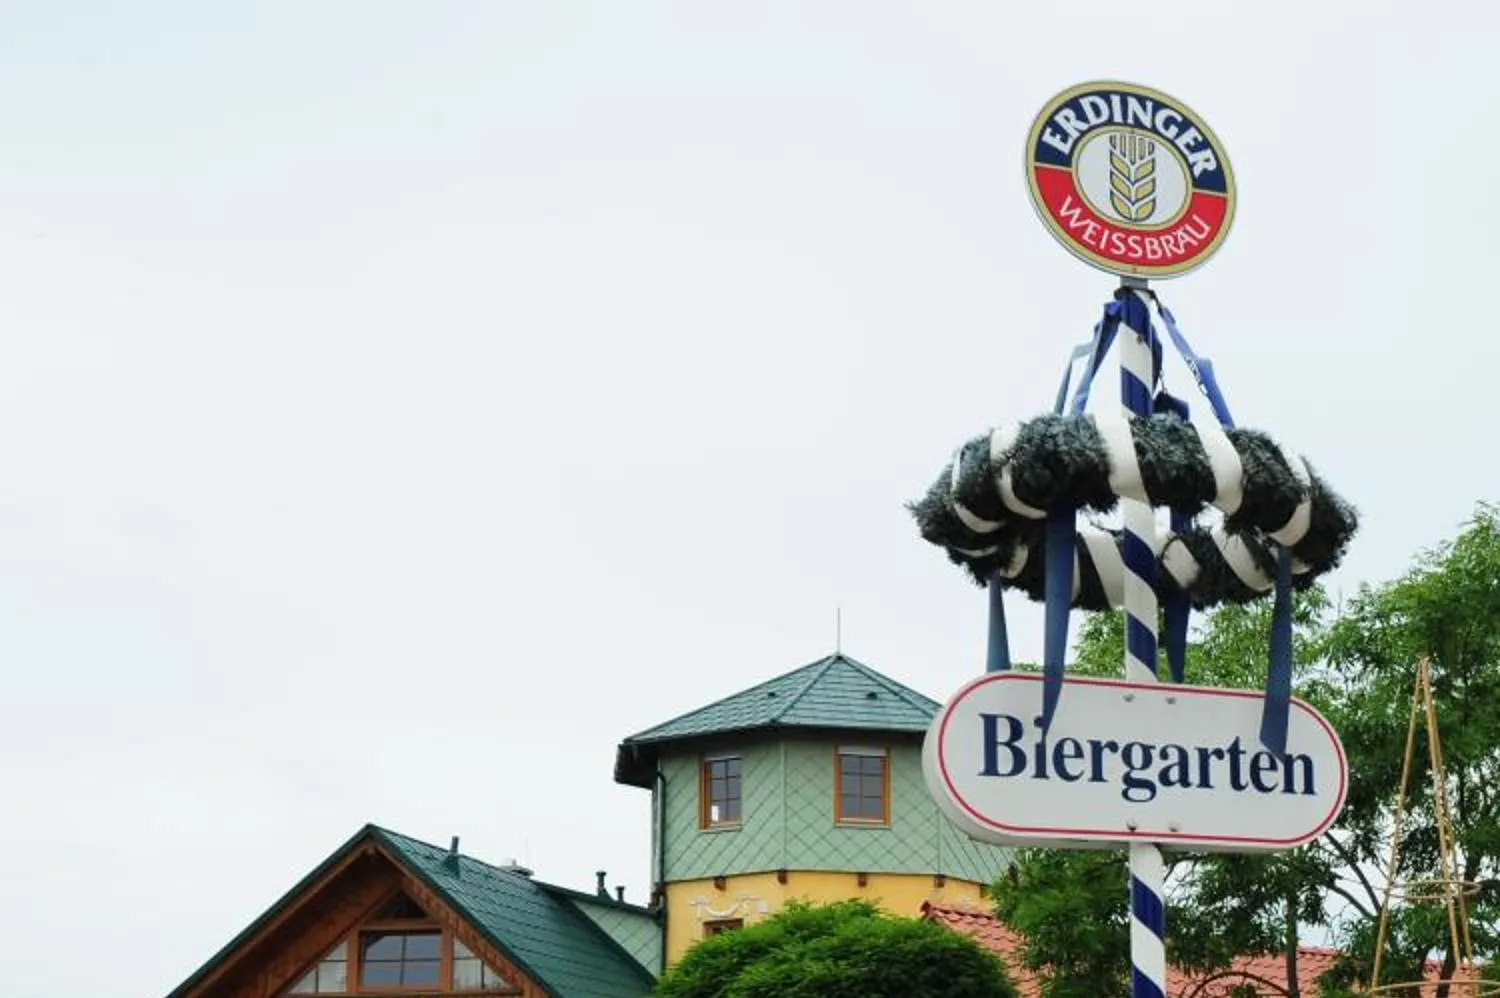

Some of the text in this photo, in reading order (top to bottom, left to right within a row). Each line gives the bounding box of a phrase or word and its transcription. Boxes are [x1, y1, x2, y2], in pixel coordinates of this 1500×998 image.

[1041, 93, 1218, 179] ERDINGER
[1058, 195, 1212, 260] WEISSBRÄU
[976, 712, 1317, 803] Biergarten
